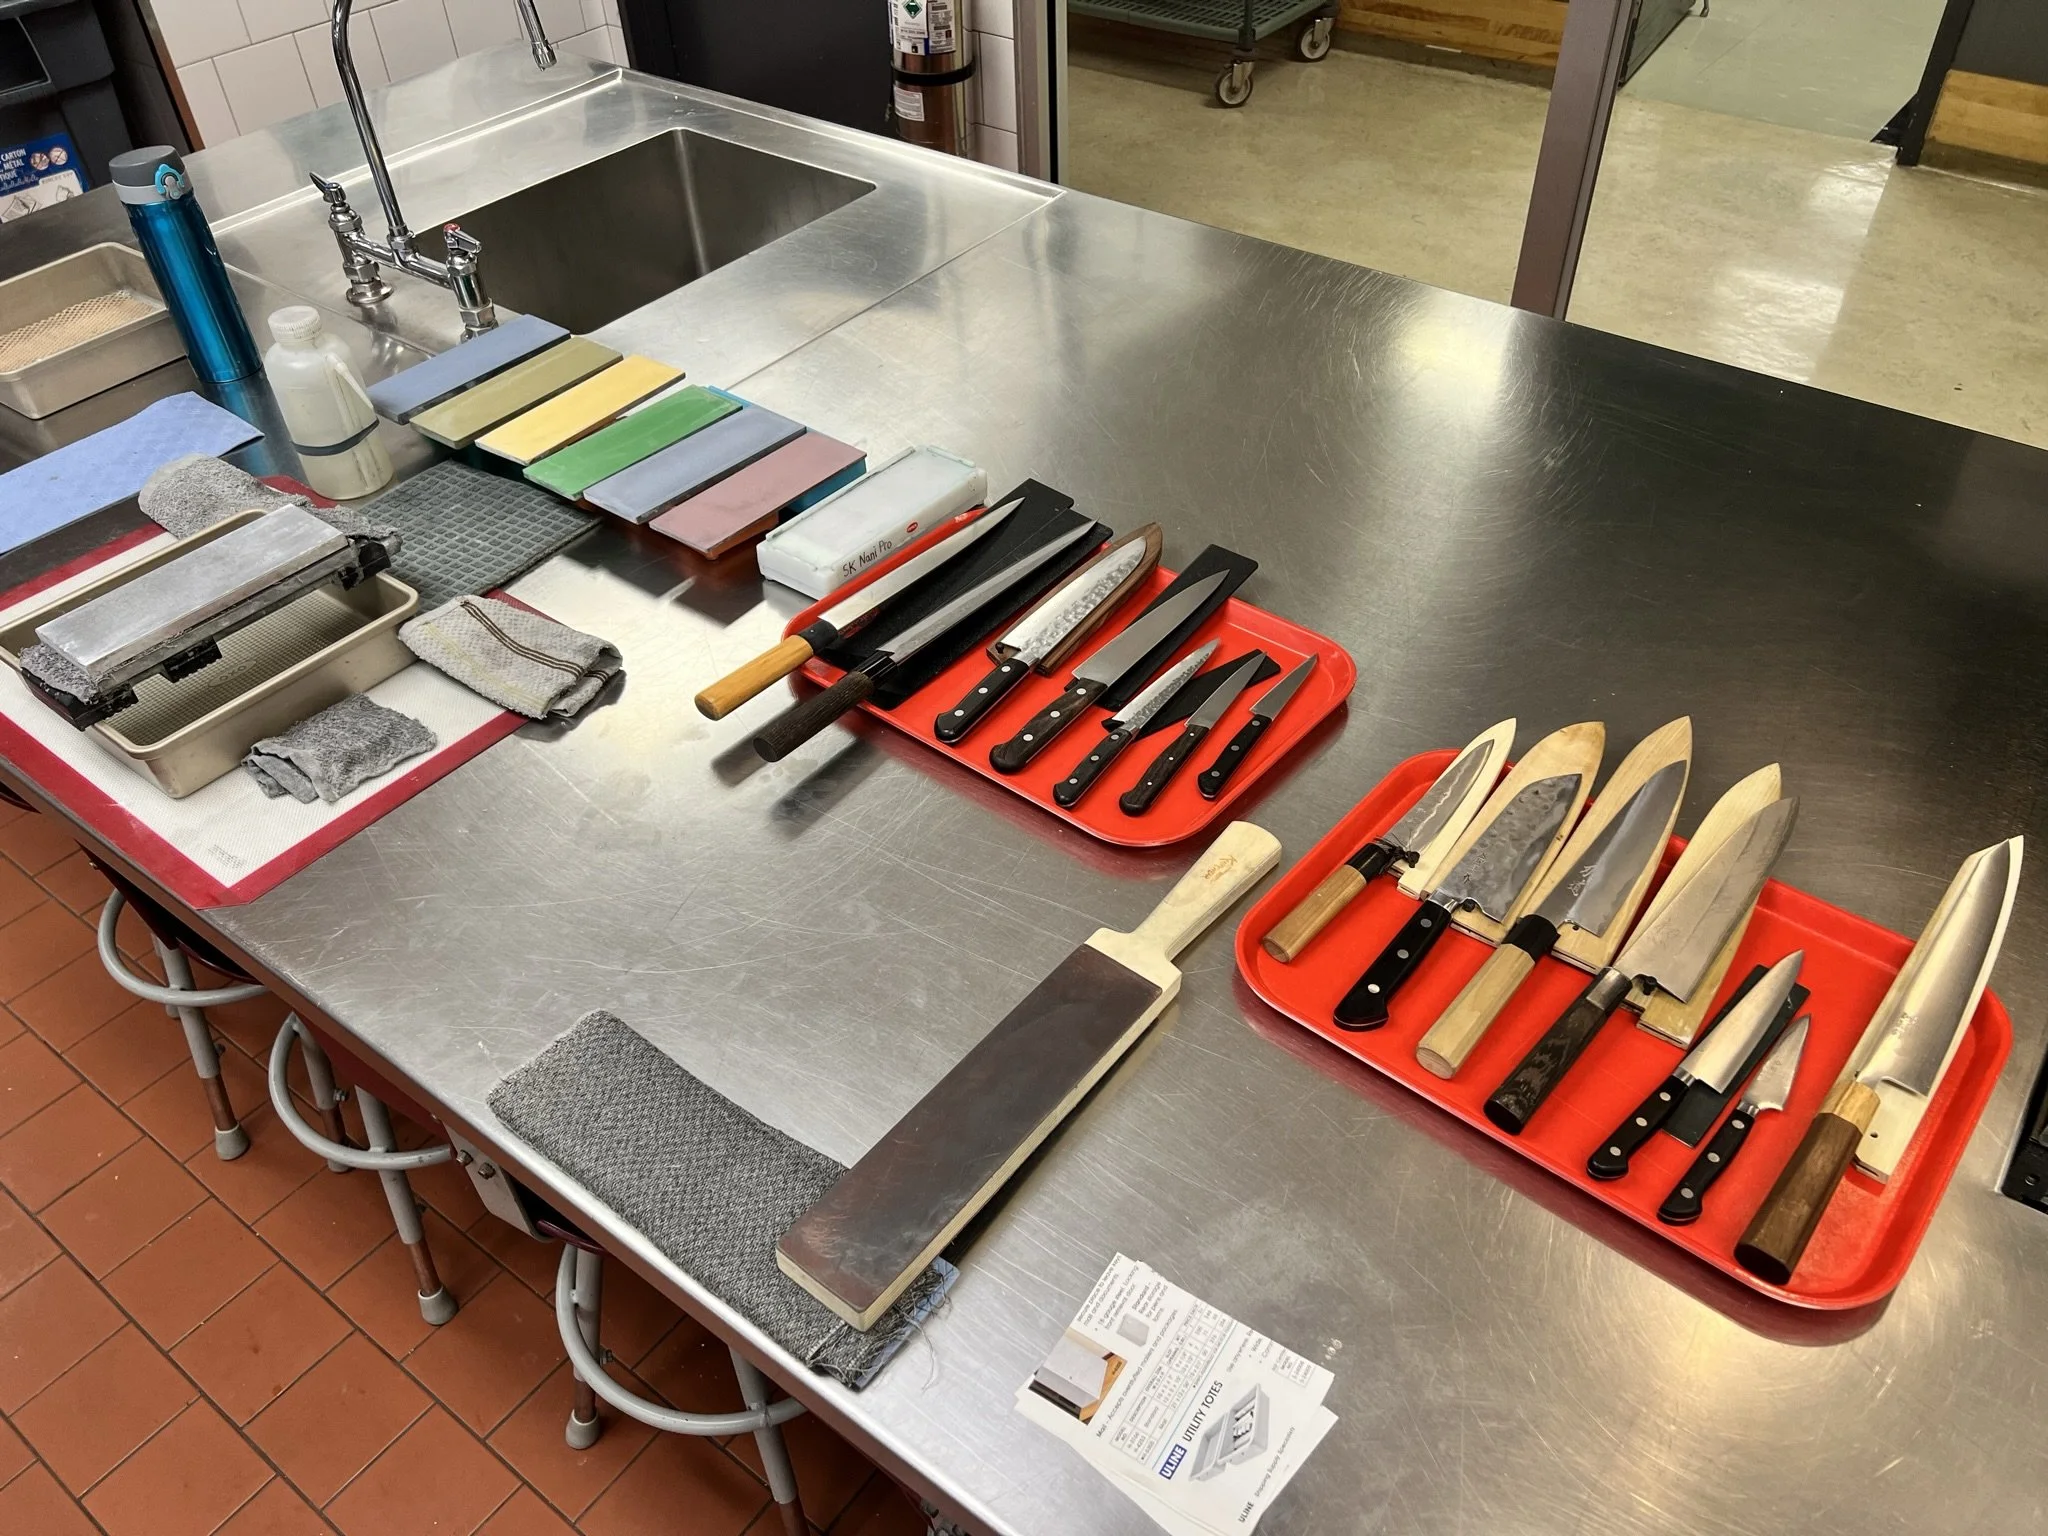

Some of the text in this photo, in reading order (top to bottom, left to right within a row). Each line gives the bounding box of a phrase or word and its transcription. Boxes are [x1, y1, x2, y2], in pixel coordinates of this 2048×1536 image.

[1, 148, 26, 161] CARTON
[842, 559, 857, 577] SK
[879, 540, 893, 553] Pro
[1088, 1287, 1101, 1305] place
[1159, 1284, 1169, 1297] and
[1091, 1301, 1101, 1314] and
[1103, 1300, 1117, 1319] gauge
[1096, 1424, 1107, 1438] Mail
[1107, 1396, 1125, 1421] Accepts
[1152, 1335, 1162, 1348] and
[1160, 1446, 1185, 1477] ULINE
[1182, 1408, 1206, 1442] UTILITY
[1201, 1381, 1223, 1409] TOTES
[1238, 1502, 1254, 1523] ULINE
